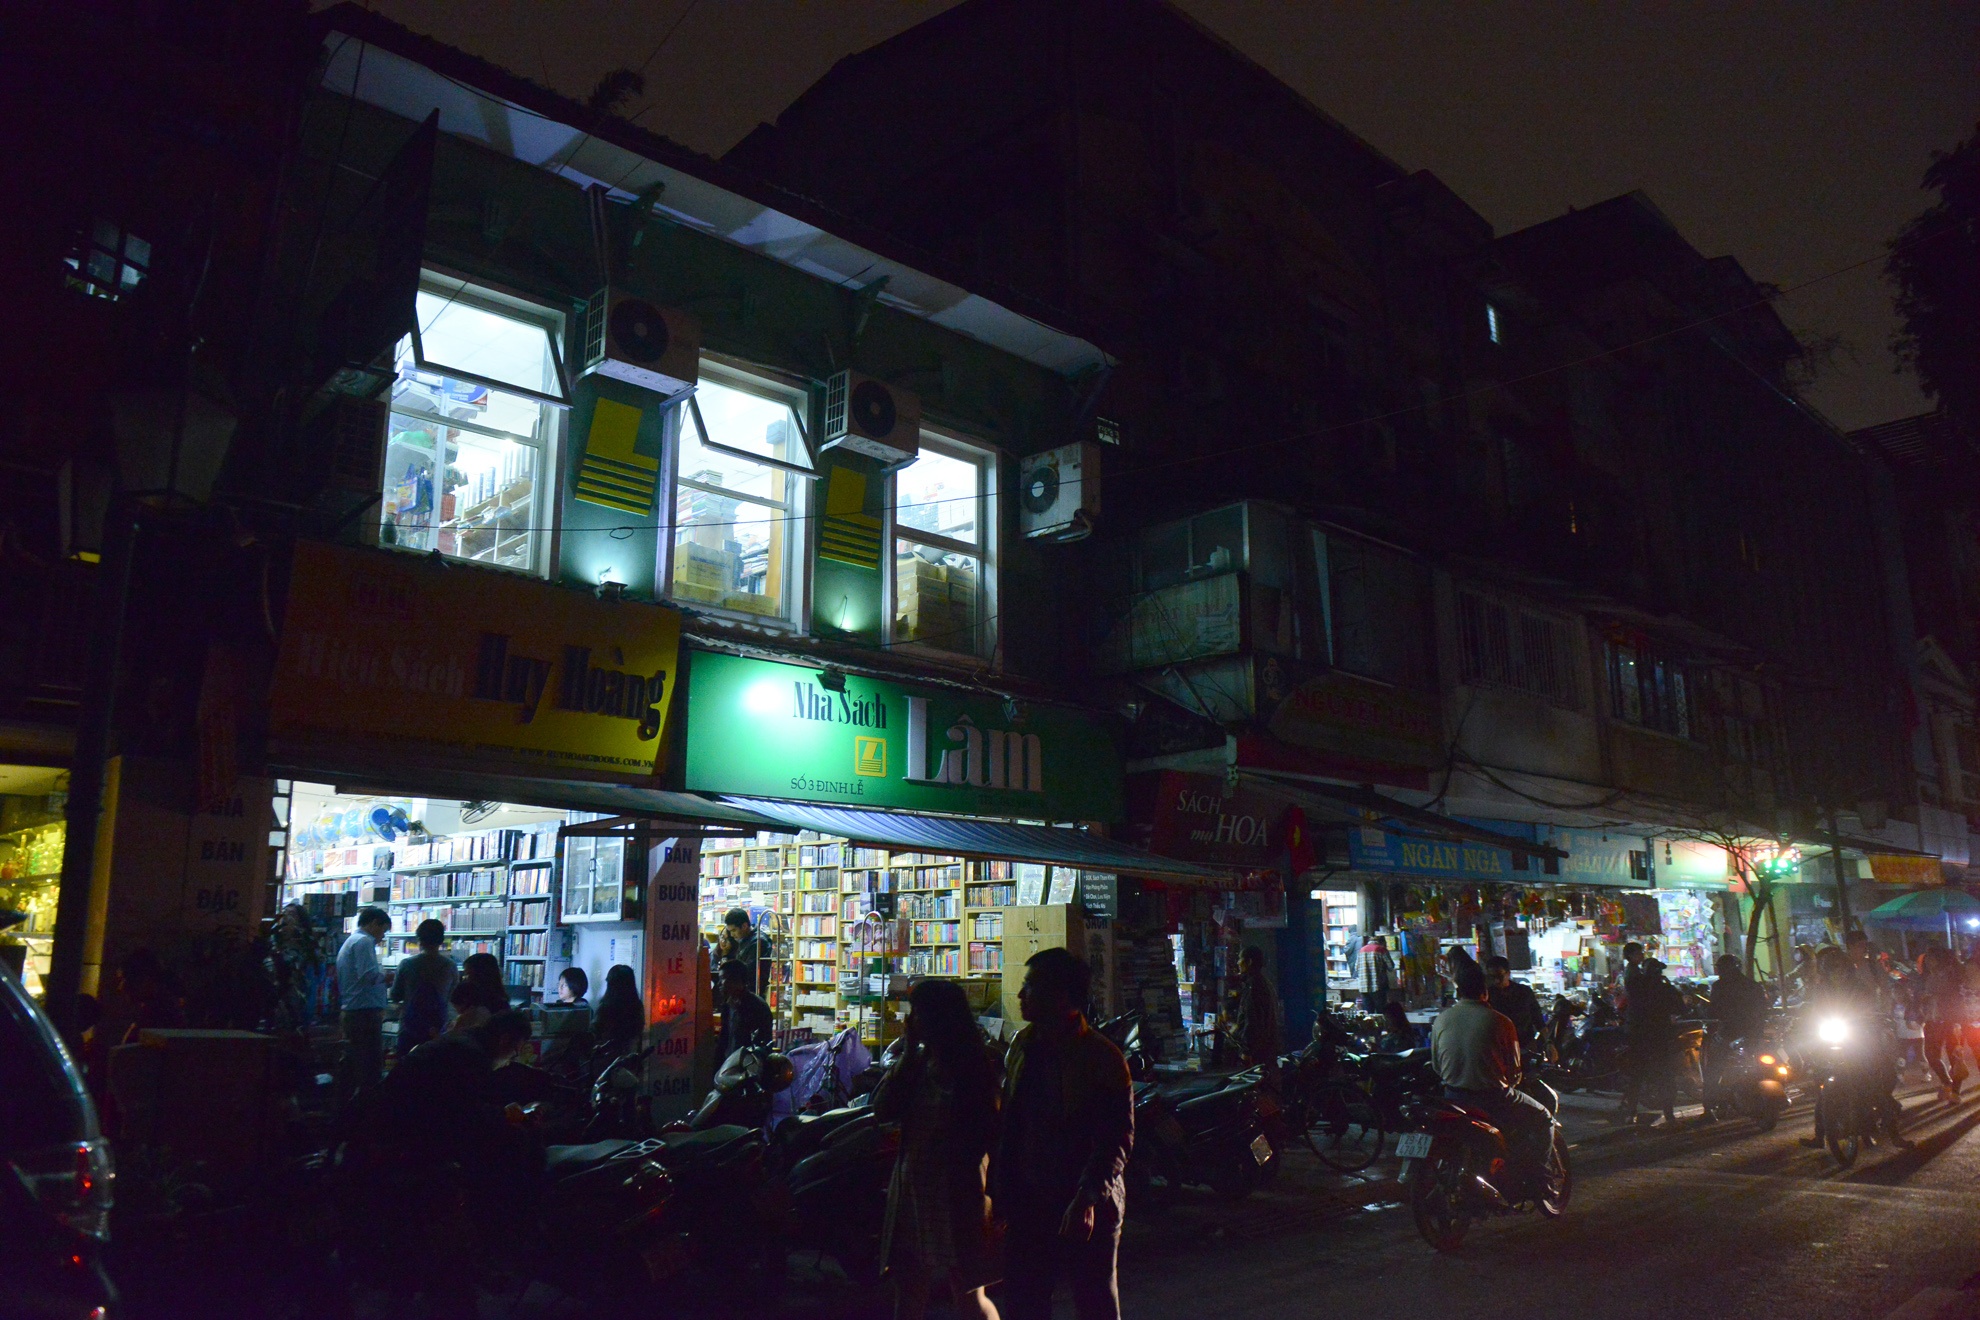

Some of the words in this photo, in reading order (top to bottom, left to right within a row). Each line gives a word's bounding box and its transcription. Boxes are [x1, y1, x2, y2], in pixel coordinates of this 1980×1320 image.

[474, 631, 555, 725] Huy
[552, 644, 666, 741] Hoàng
[838, 690, 887, 730] Sách
[902, 695, 1043, 793] Lâm
[791, 773, 807, 790] SỐ
[808, 779, 815, 791] 3
[816, 780, 848, 794] ĐINH
[1176, 789, 1222, 815] SÁCH
[1214, 813, 1268, 847] HOA
[664, 846, 692, 864] BÁN
[658, 880, 697, 901] BUÔN
[661, 922, 690, 941] BÁN
